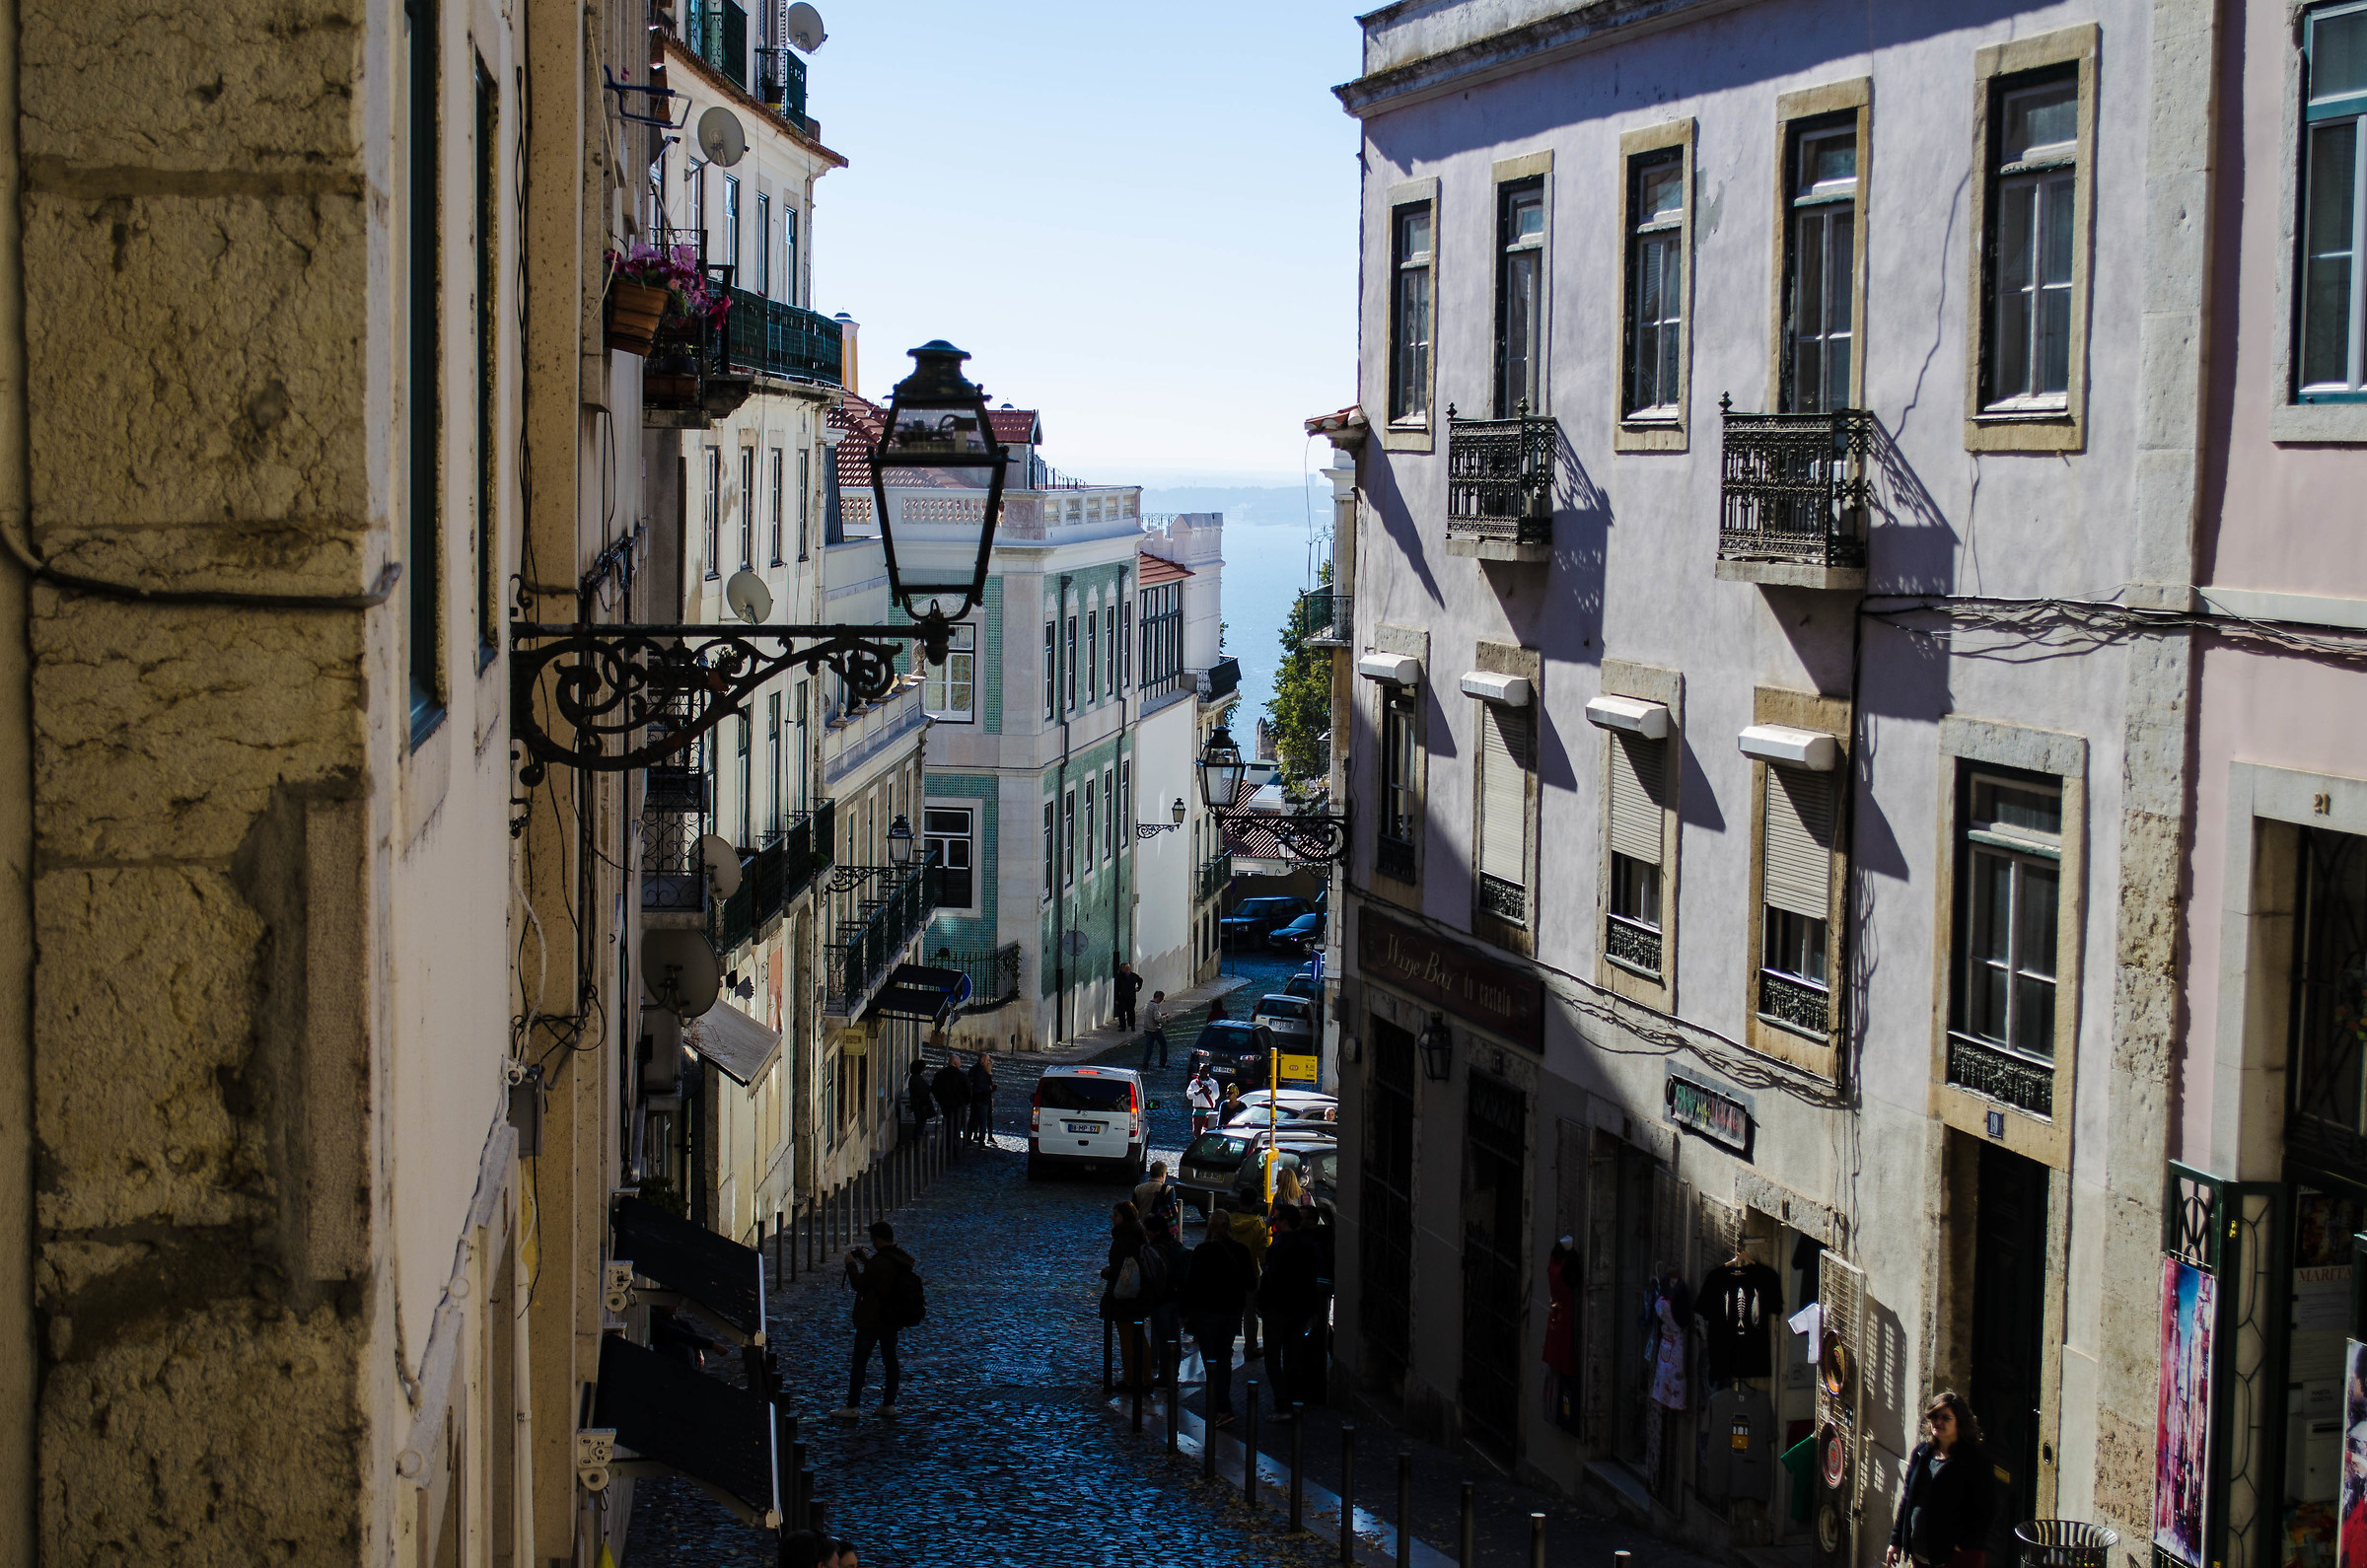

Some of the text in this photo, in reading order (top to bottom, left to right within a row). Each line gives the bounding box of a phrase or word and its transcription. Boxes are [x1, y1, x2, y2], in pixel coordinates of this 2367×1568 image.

[1375, 932, 1420, 980] Wine
[1422, 951, 1458, 991] Bar
[1990, 1113, 1998, 1134] 19
[2299, 1266, 2352, 1283] MARITA
